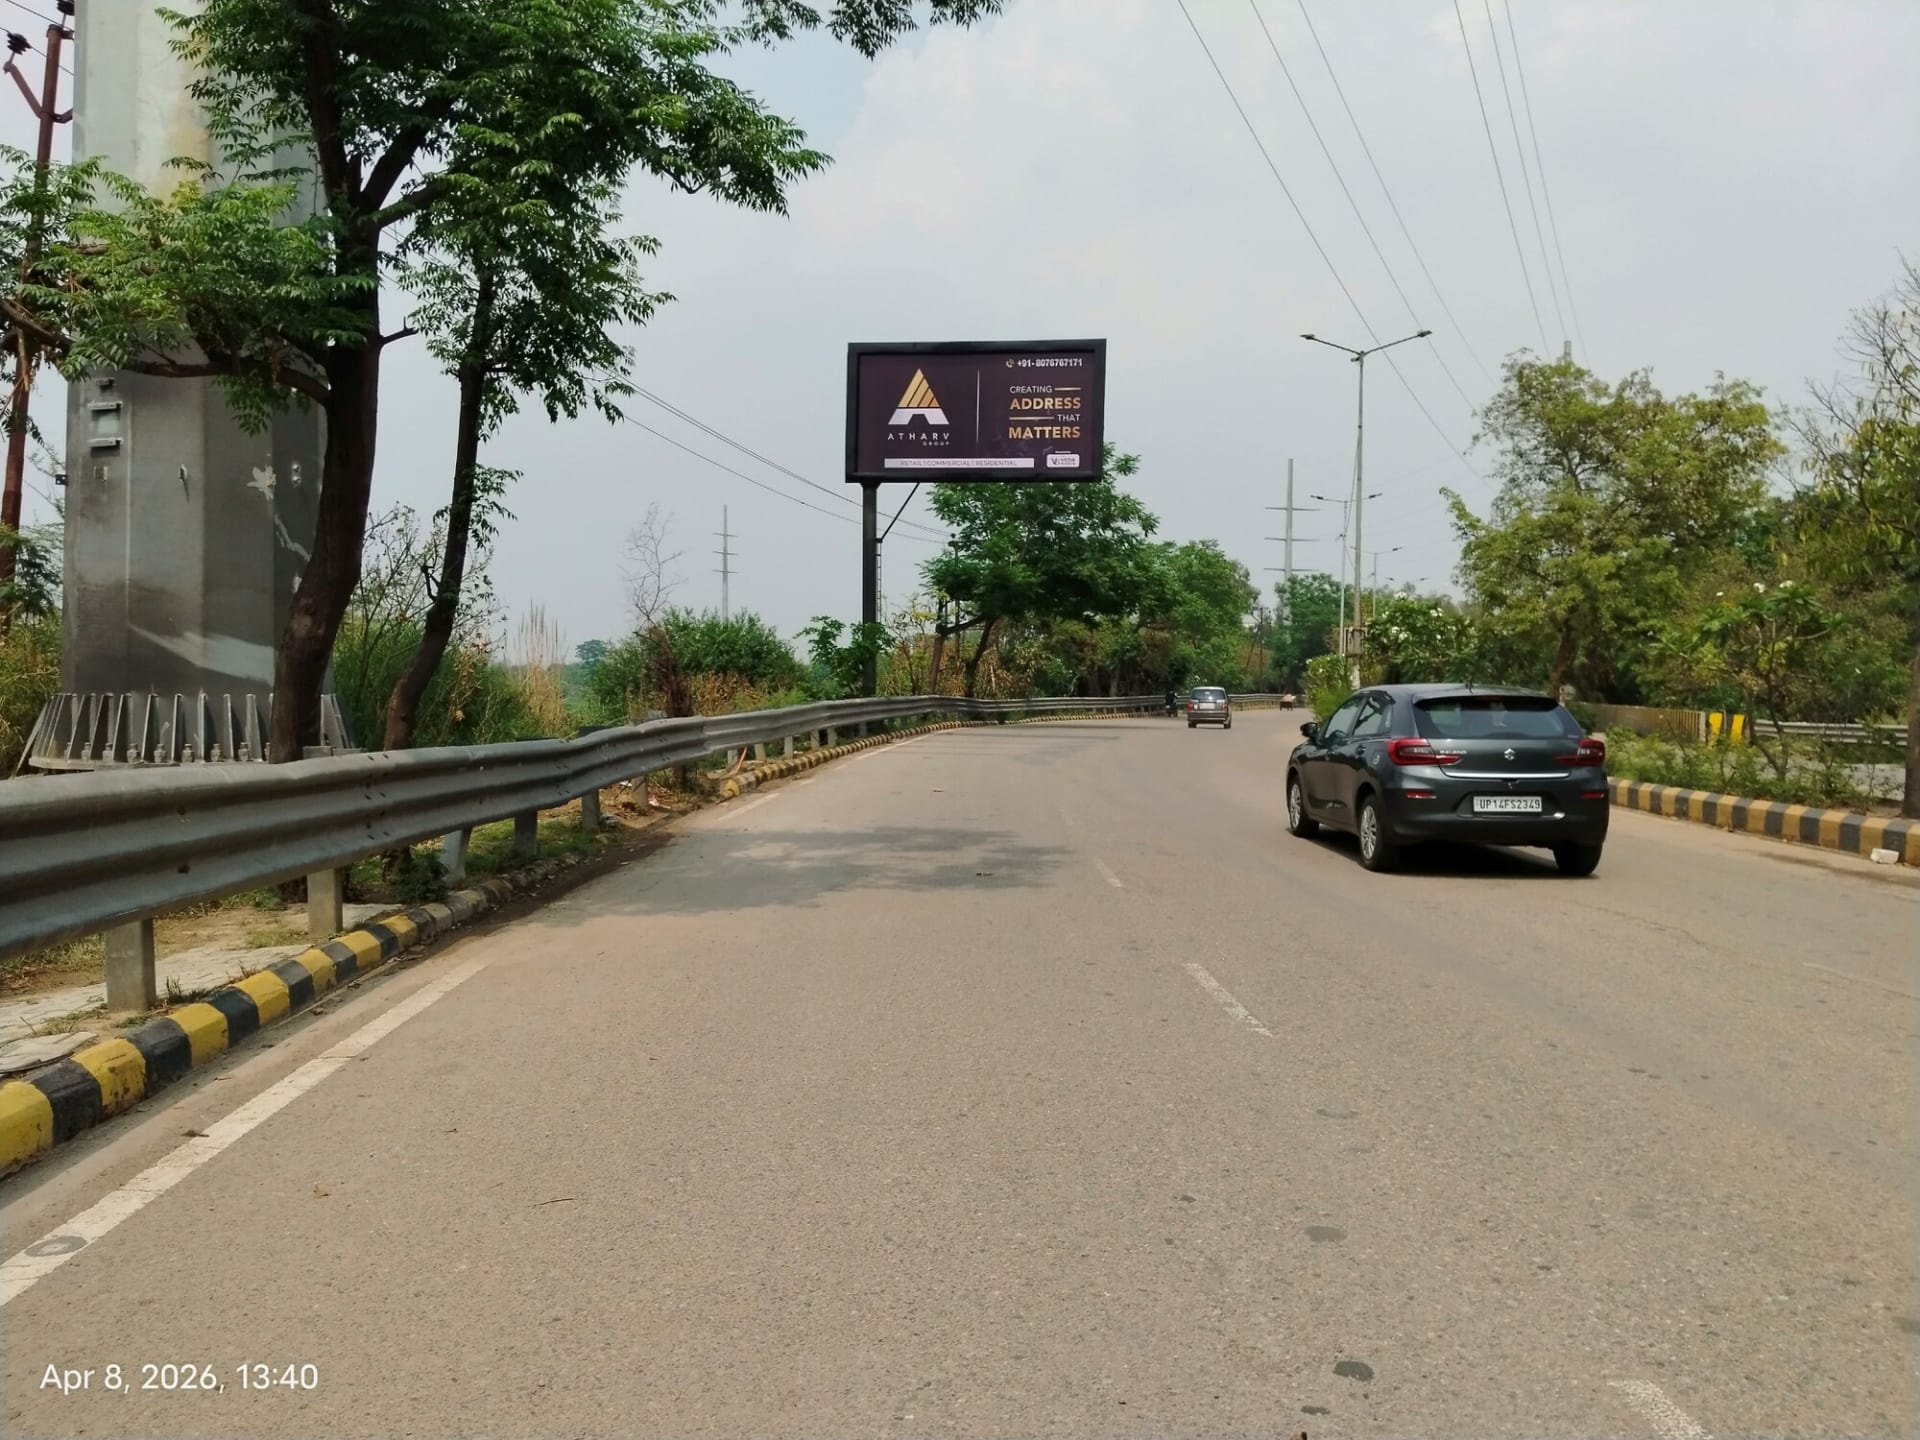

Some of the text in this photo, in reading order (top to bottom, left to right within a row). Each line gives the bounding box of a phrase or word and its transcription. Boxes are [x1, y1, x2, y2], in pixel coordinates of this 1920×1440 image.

[1009, 385, 1053, 394] CREATING
[1009, 397, 1081, 410] ADDRESS
[1057, 414, 1081, 422] THAT
[887, 432, 950, 440] ATHARV
[1008, 426, 1081, 439] MATTERS
[1480, 798, 1540, 809] UP14FS2349
